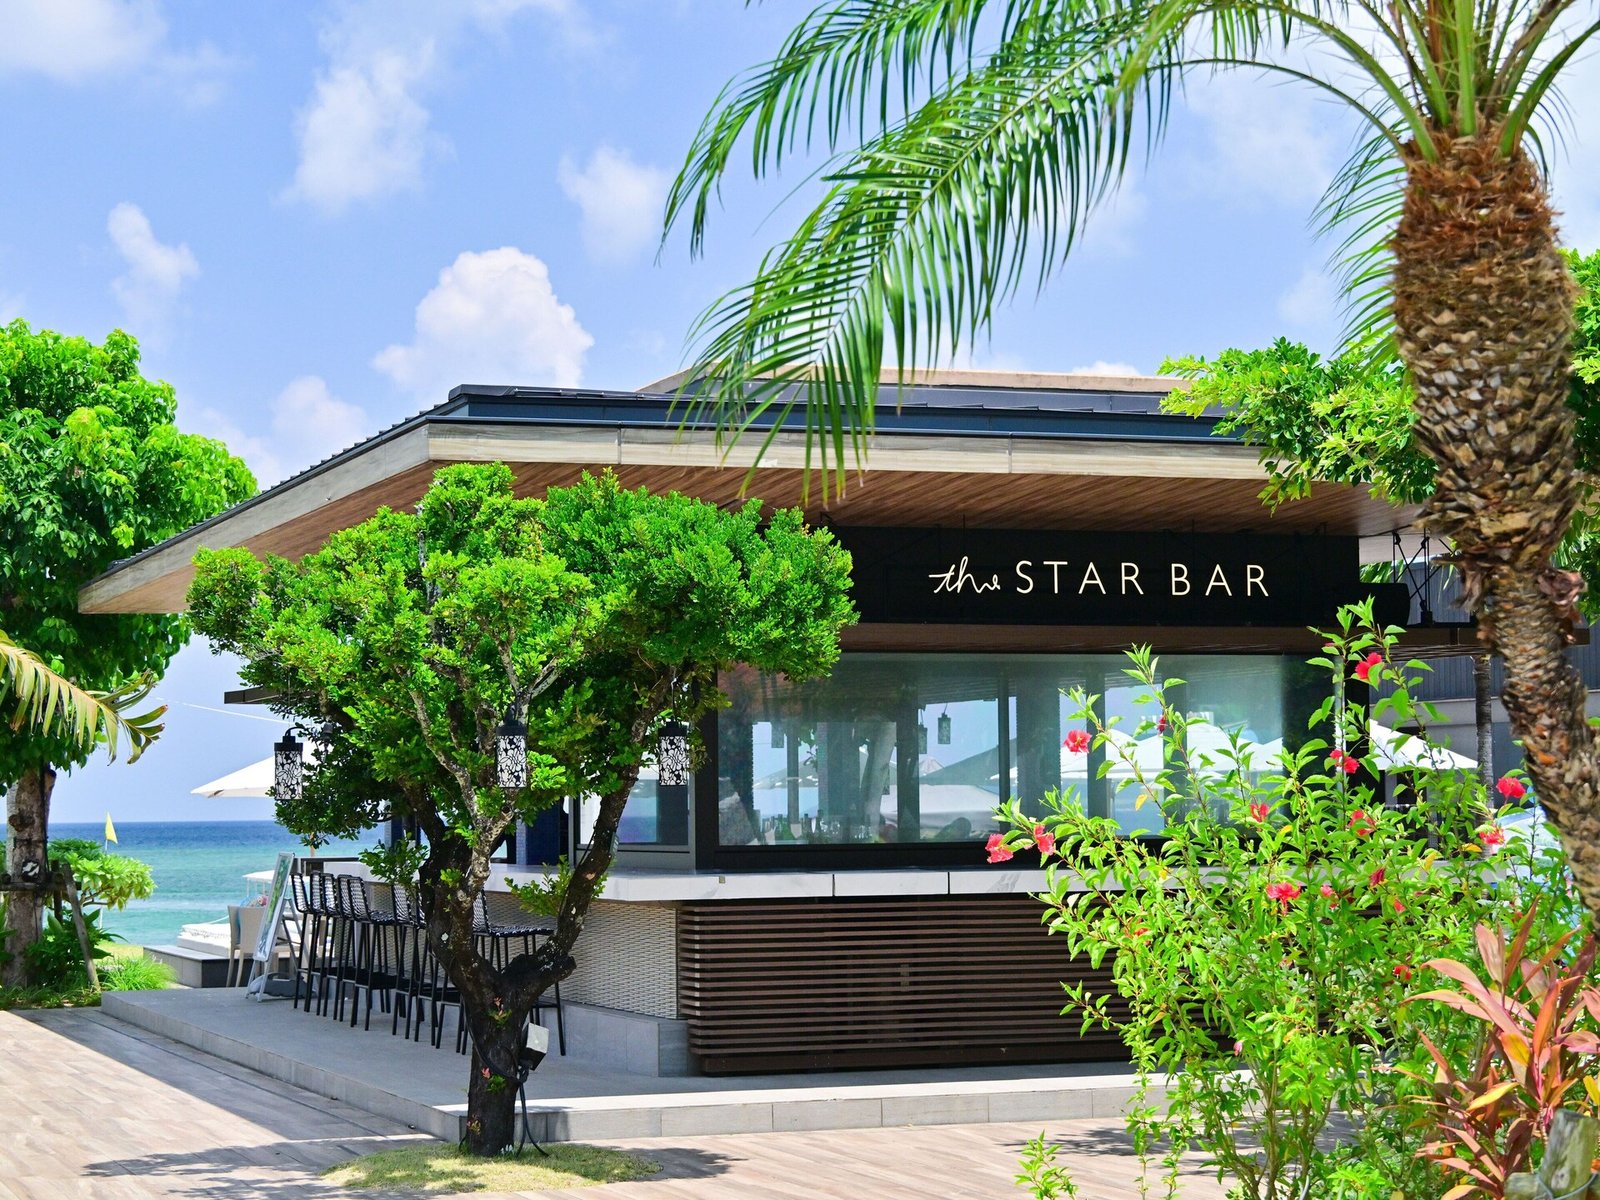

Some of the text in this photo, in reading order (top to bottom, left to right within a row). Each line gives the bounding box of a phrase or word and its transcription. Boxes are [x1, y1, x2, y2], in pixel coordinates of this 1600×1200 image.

[928, 555, 1269, 597] the STAR BAR
